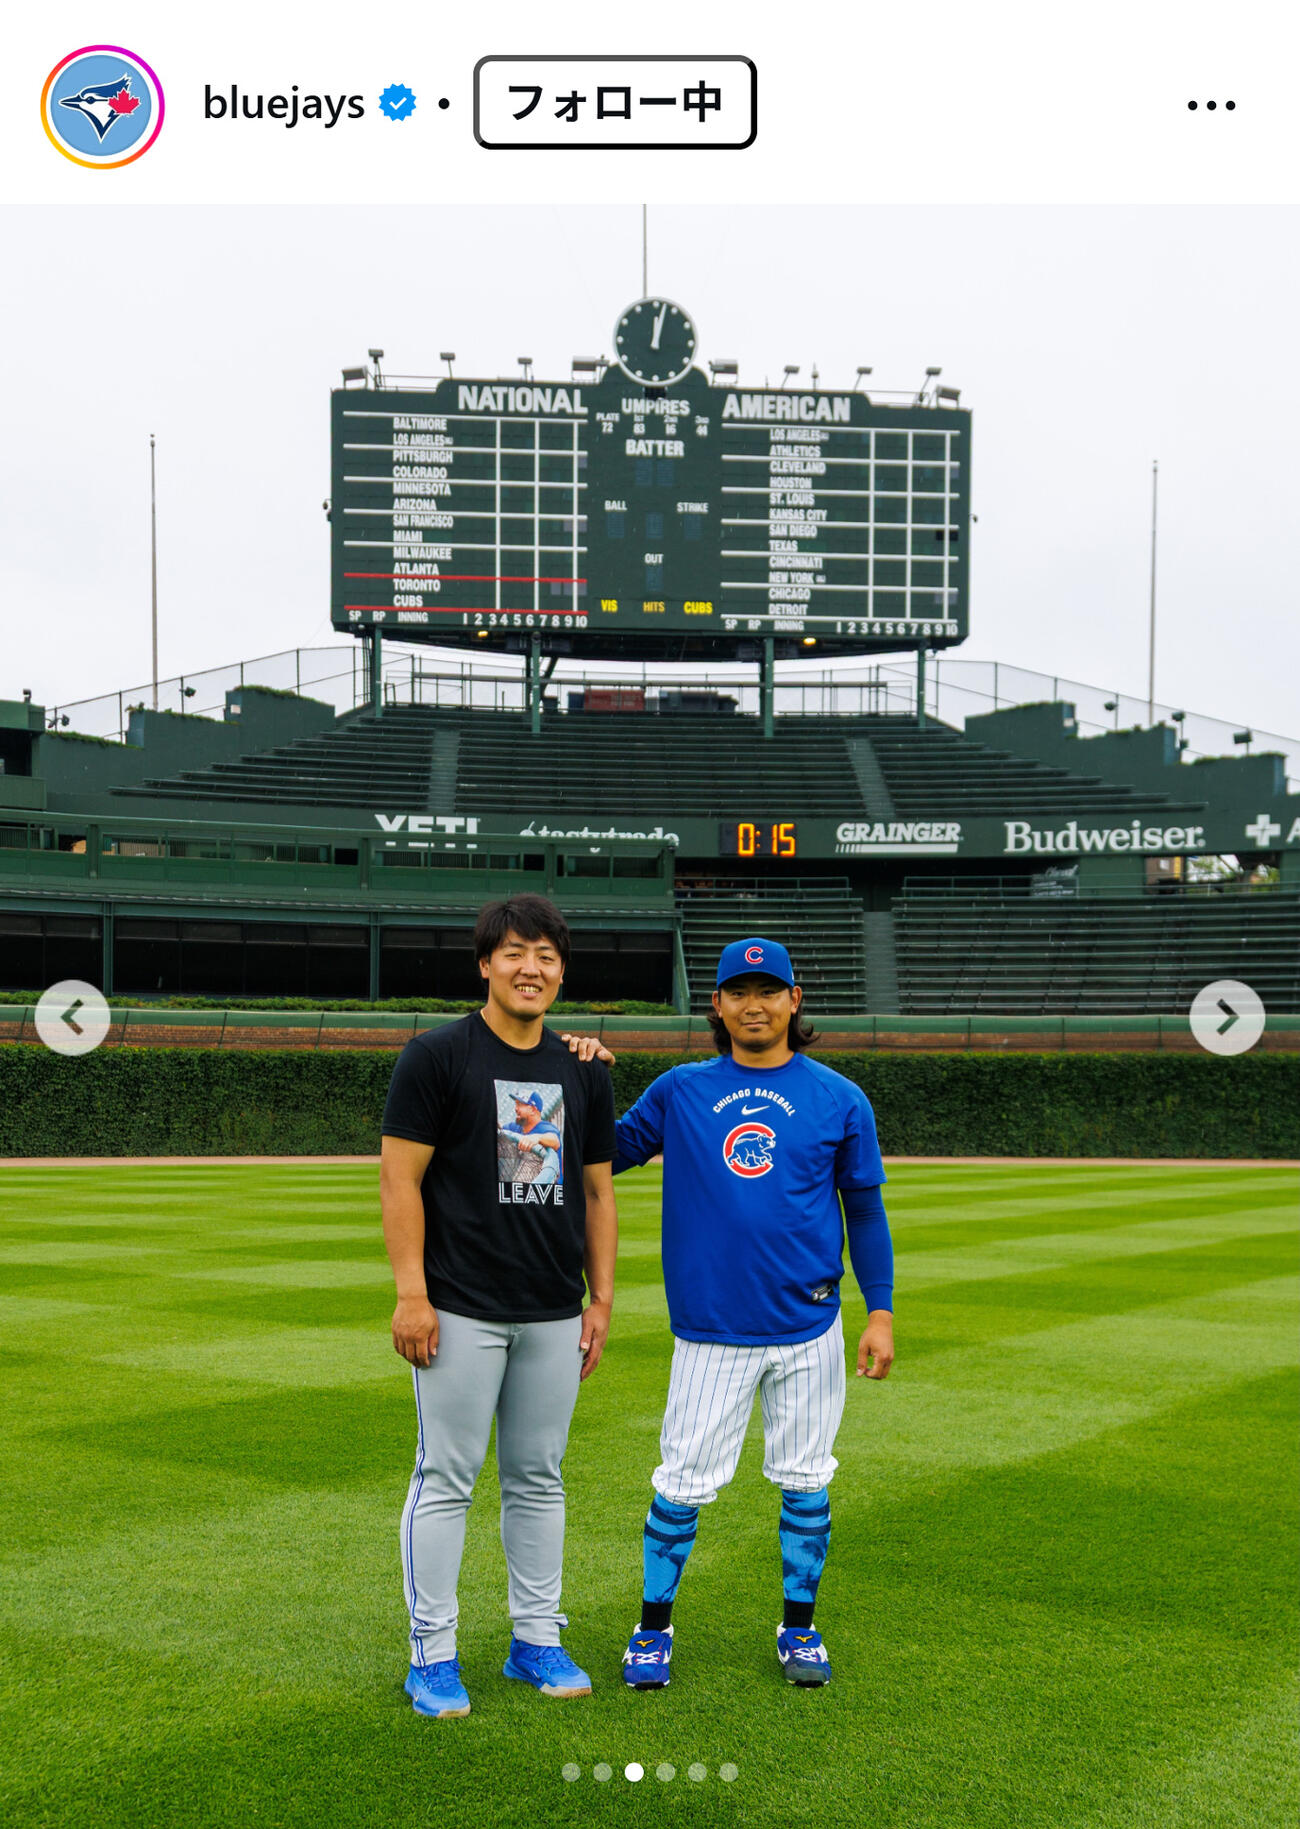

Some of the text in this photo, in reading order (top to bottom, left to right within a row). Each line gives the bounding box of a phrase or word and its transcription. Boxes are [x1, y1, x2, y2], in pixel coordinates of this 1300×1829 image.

[458, 385, 588, 413] NATIONAL
[621, 397, 691, 416] UMPIRES
[721, 394, 851, 422] AMERICAN
[393, 416, 448, 431] BALTIMORE
[596, 412, 620, 422] PLATE
[602, 421, 613, 434] 72
[393, 433, 409, 446] LOS
[410, 434, 445, 447] ANGELES
[770, 428, 786, 441] LOS
[786, 429, 820, 443] ANGELES
[625, 438, 685, 457] BATTER
[769, 444, 822, 458] ATHLETICS
[393, 449, 453, 464] PITTSBURGH
[392, 465, 448, 480] COLORADO
[769, 460, 827, 475] CLEVELAND
[393, 481, 452, 496] MINNESOTA
[769, 476, 813, 490] HOUSTON
[393, 497, 438, 511] ARIZONA
[604, 499, 709, 514] BALL STRIKE
[769, 492, 815, 506] ST. LOUIS
[393, 514, 454, 529] SAN FRANCISCO
[769, 507, 828, 522] KANSAS CITY
[393, 529, 423, 543] MIAMI
[769, 524, 818, 538] SAN DIEGO
[393, 546, 453, 560] MILWAUKEE
[768, 539, 799, 553] TEXAS
[644, 552, 664, 565] OUT
[769, 556, 823, 570] CINCINNATI
[393, 562, 440, 576] ATLANTA
[393, 578, 441, 593] TORONTO
[768, 571, 789, 584] NEW
[789, 572, 815, 585] YORK
[393, 594, 424, 608] CUBS
[768, 587, 812, 601] CHICAGO
[601, 599, 714, 616] VIS HITS CUBS
[768, 603, 808, 616] DETROIT
[348, 610, 588, 630] SP RP INNING 1 2 3 4 5 6 7 8 9 10
[725, 619, 959, 636] SP RP INNING 1 2 3 4 5 6 7 8 9 10
[374, 814, 478, 849] YETI
[836, 822, 961, 842] GRAINGER
[1003, 819, 1204, 852] Budweiser
[737, 822, 796, 857] 0:15
[744, 946, 764, 965] C
[712, 1087, 796, 1117] CHICAGO BASEBALL
[498, 1181, 564, 1205] LEAVE
